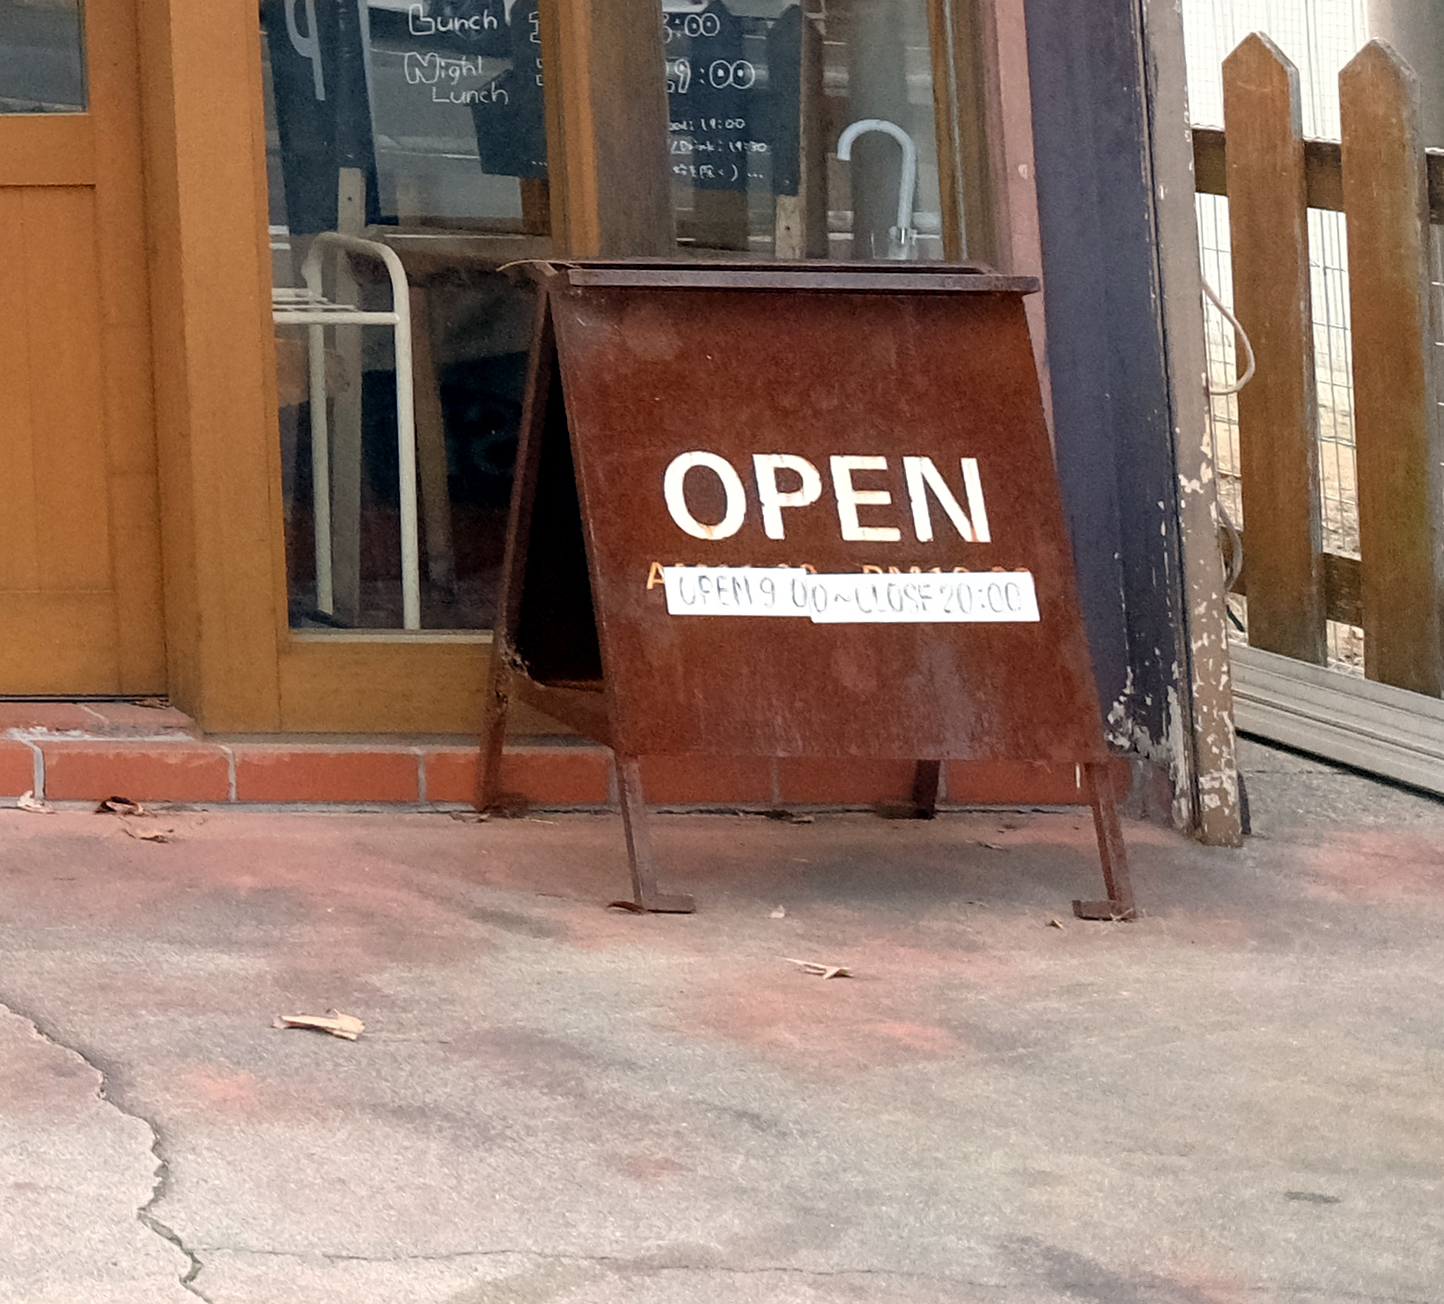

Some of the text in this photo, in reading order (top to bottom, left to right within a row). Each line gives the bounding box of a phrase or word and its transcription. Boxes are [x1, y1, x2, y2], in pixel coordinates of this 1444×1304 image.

[408, 3, 499, 36] Lunch
[431, 80, 510, 105] Lunch
[662, 449, 992, 544] OPEN
